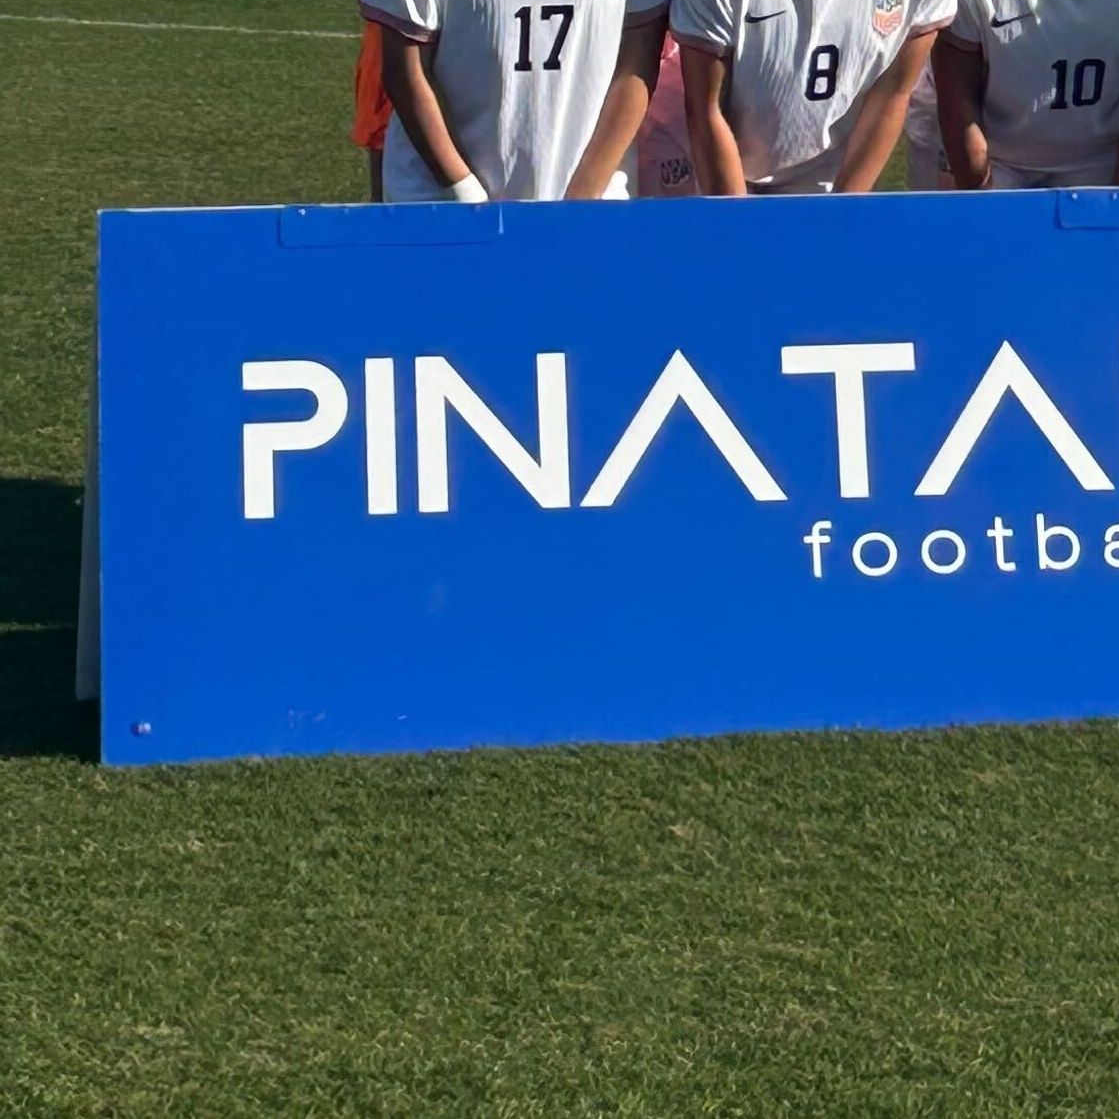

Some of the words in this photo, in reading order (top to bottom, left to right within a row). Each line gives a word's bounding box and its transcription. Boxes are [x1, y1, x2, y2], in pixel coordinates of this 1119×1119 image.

[514, 4, 574, 71] 17
[804, 44, 840, 102] 8
[1050, 59, 1106, 110] 10
